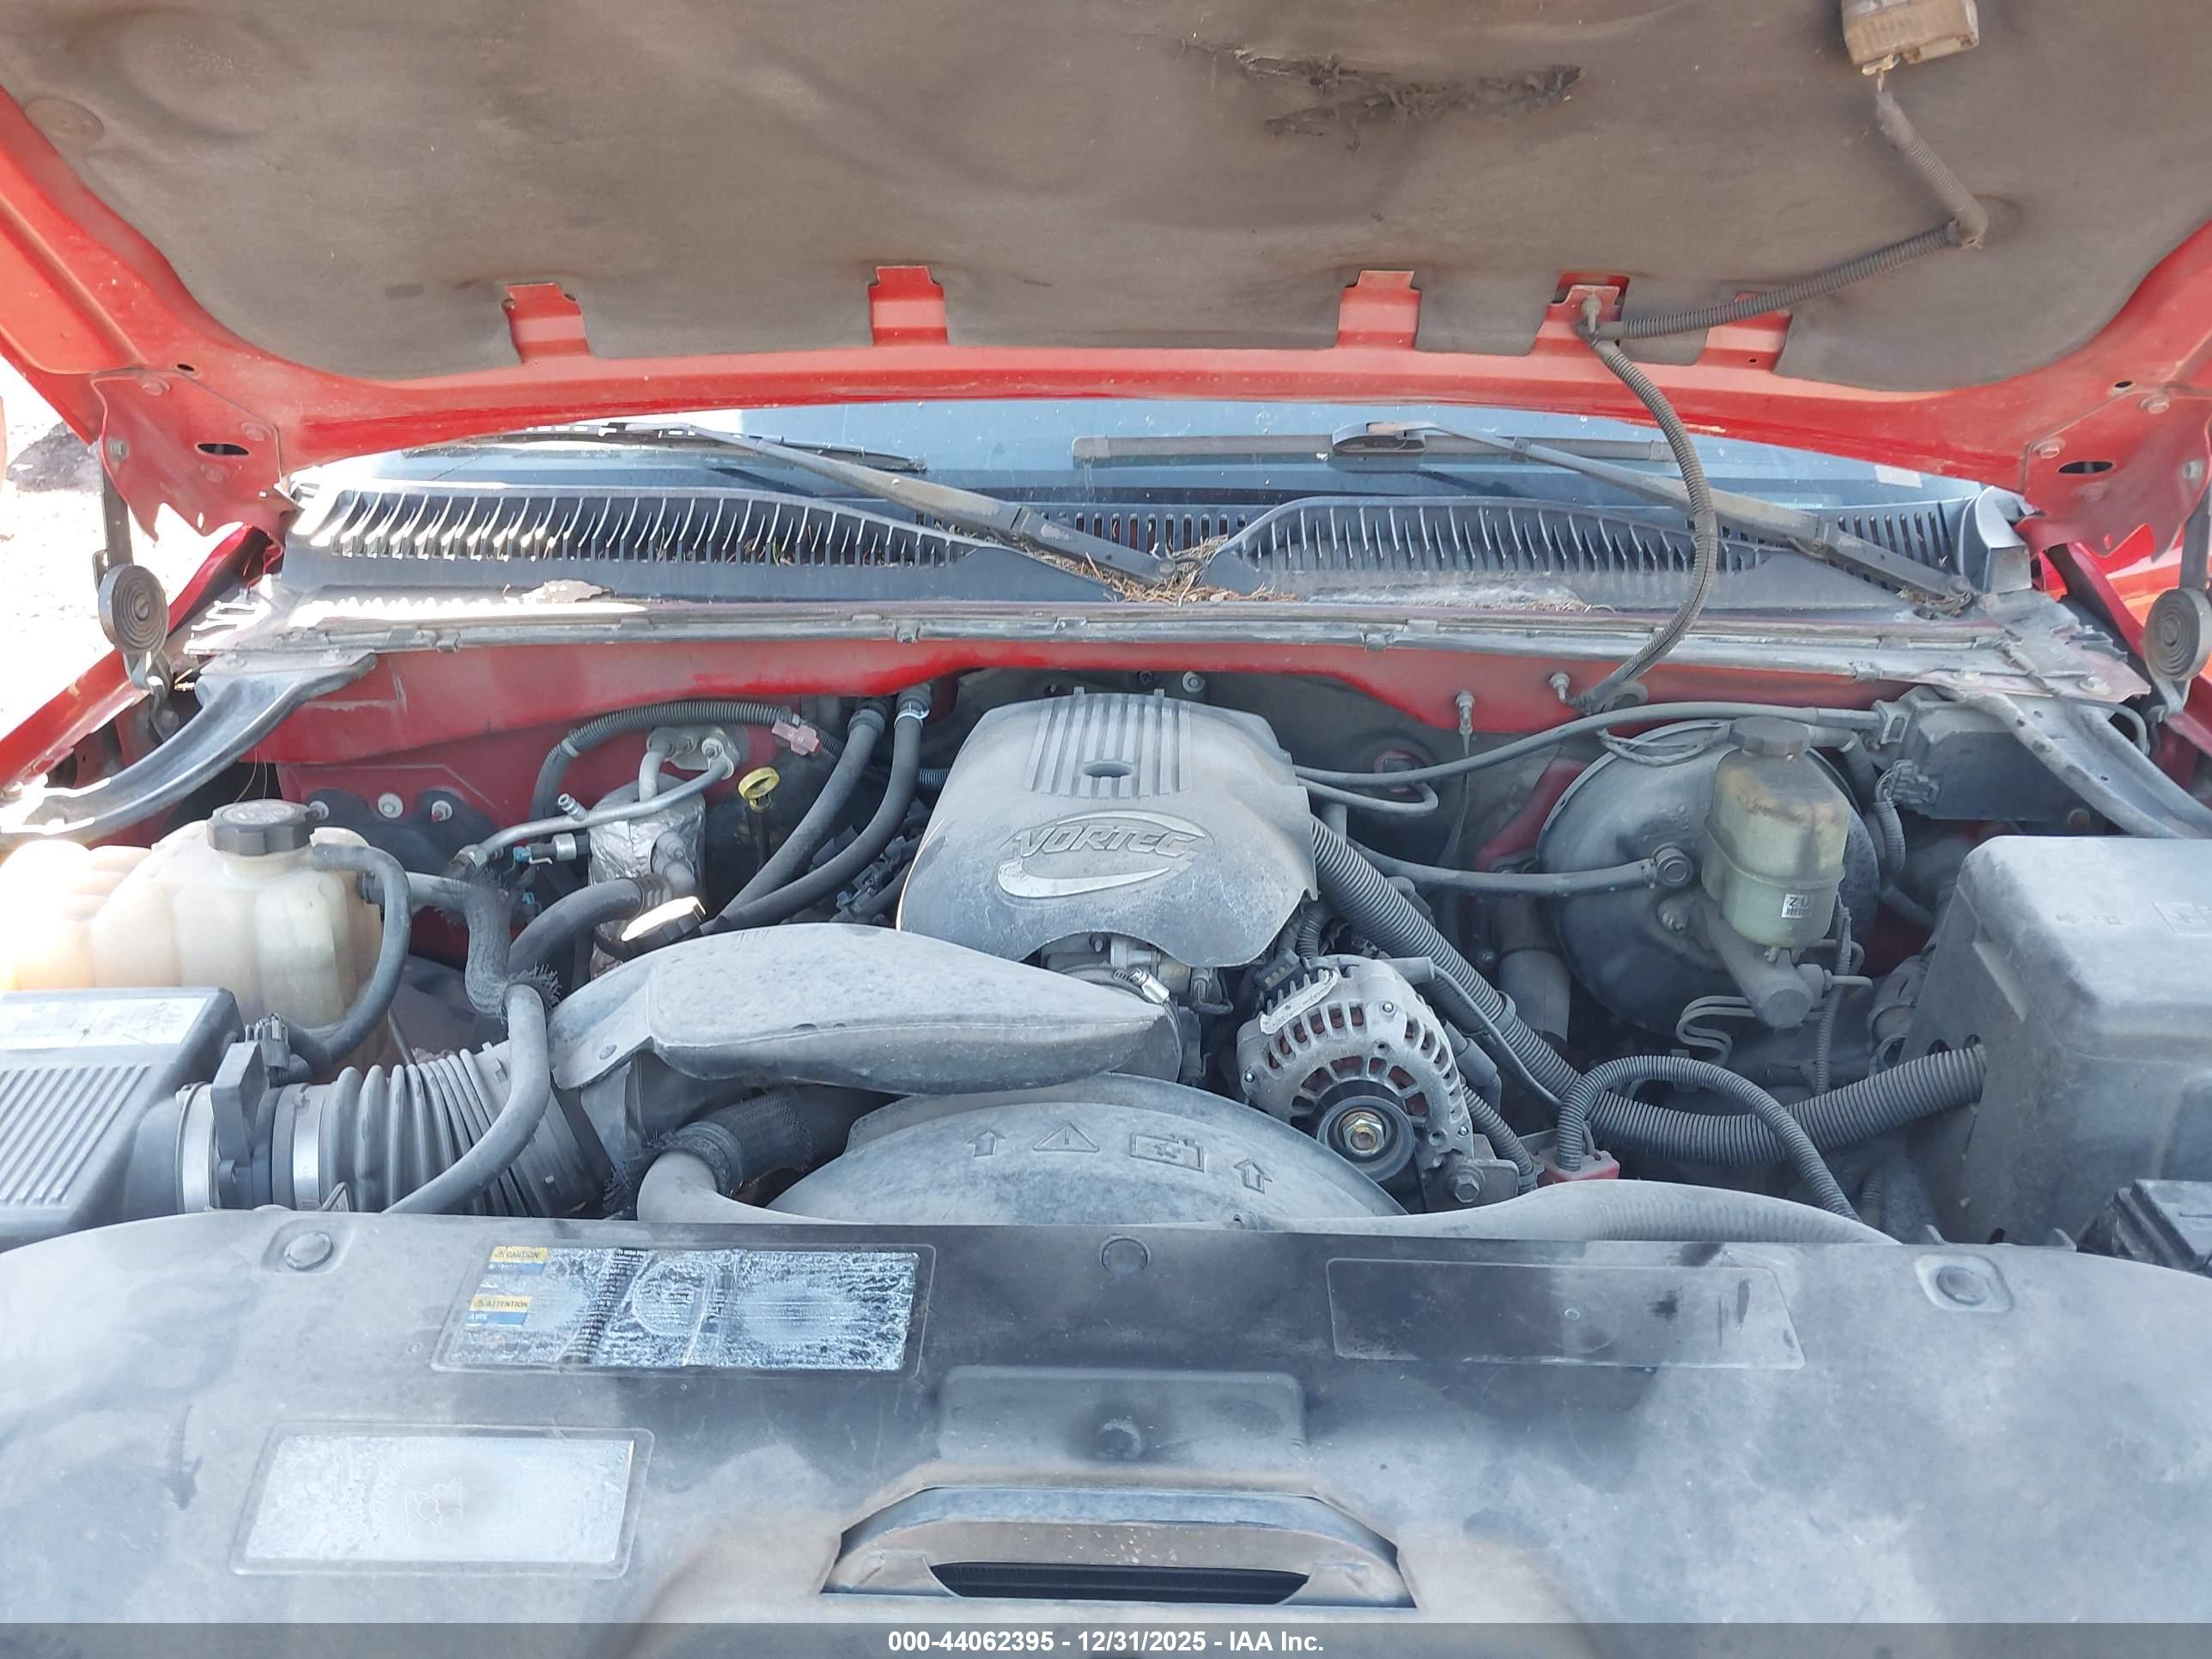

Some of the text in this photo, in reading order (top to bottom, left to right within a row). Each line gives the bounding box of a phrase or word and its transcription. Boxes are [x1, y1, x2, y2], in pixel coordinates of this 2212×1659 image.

[1015, 824, 1196, 858] VORTEC
[507, 1250, 538, 1259] CAUTION
[487, 1299, 529, 1308] ATTENTION
